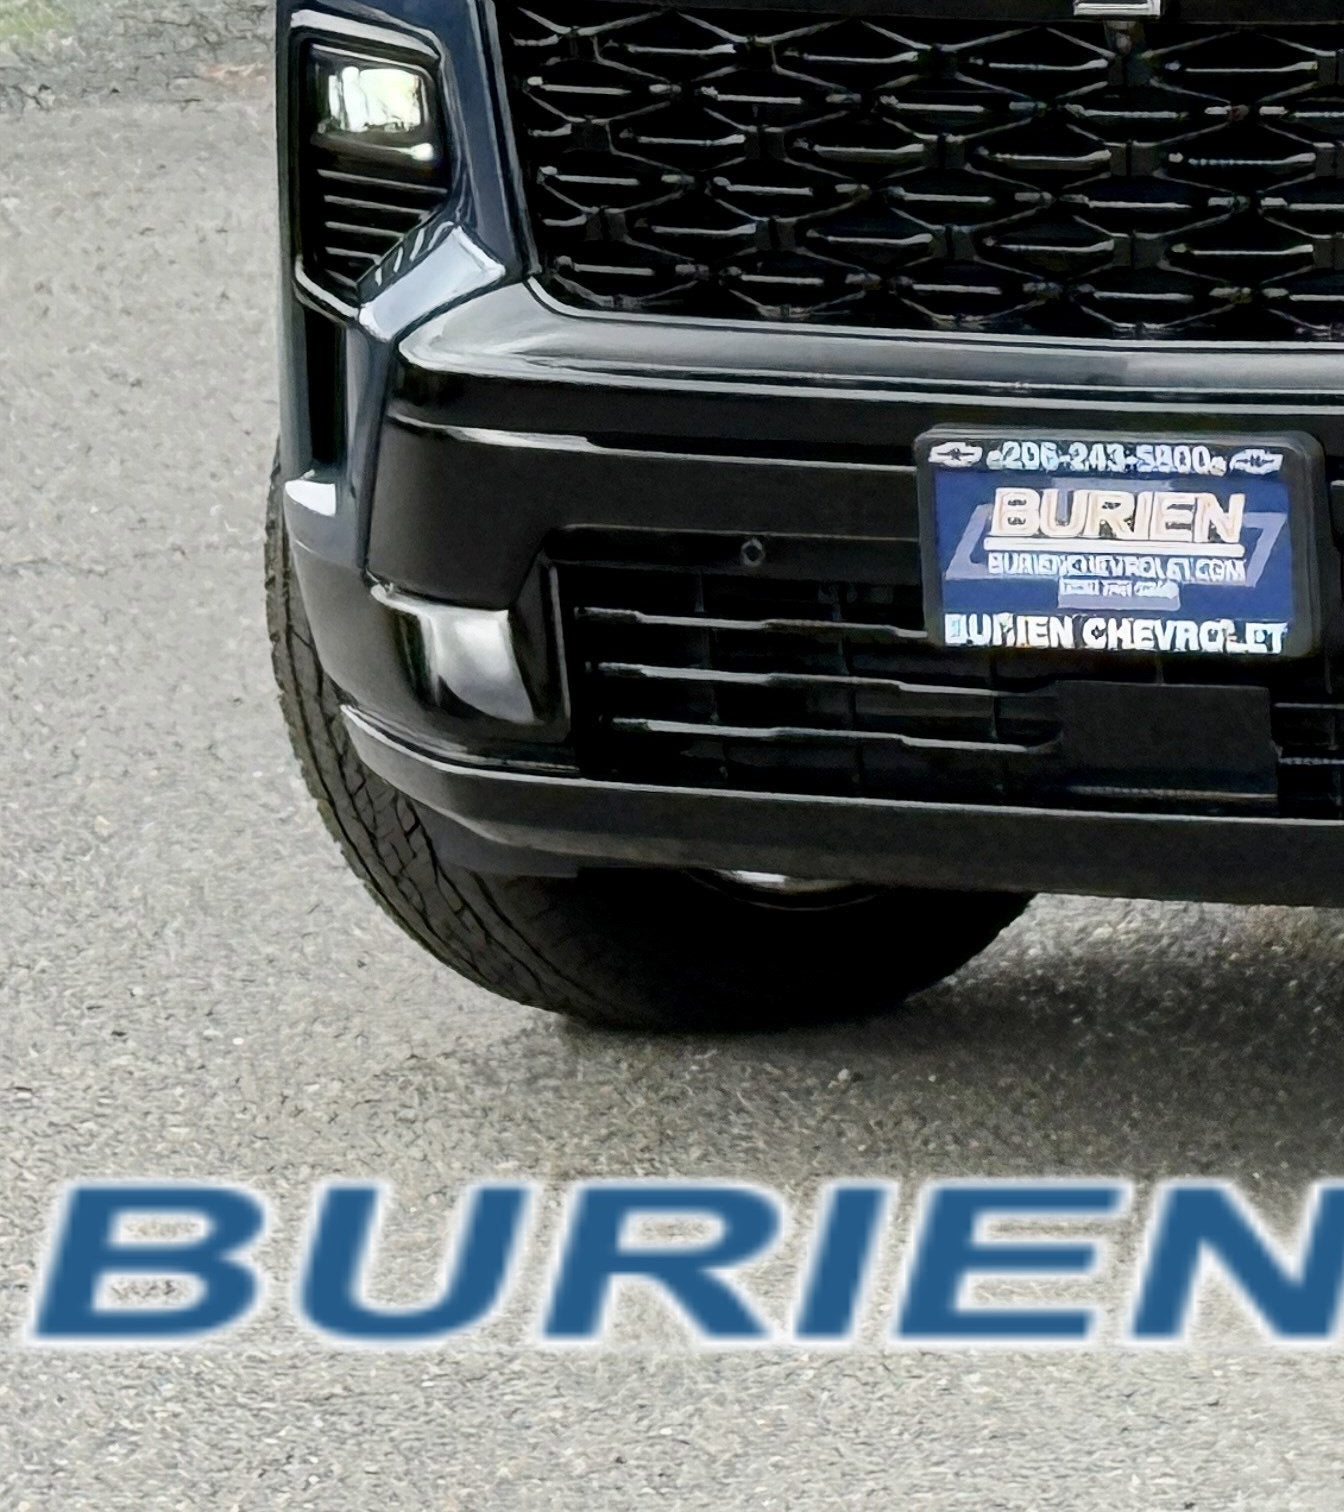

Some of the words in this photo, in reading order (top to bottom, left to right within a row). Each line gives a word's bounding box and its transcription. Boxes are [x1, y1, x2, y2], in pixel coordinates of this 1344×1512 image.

[989, 487, 1246, 543] BURIEN
[944, 612, 1073, 649] BURIEN
[1082, 616, 1288, 655] CHEVROLET
